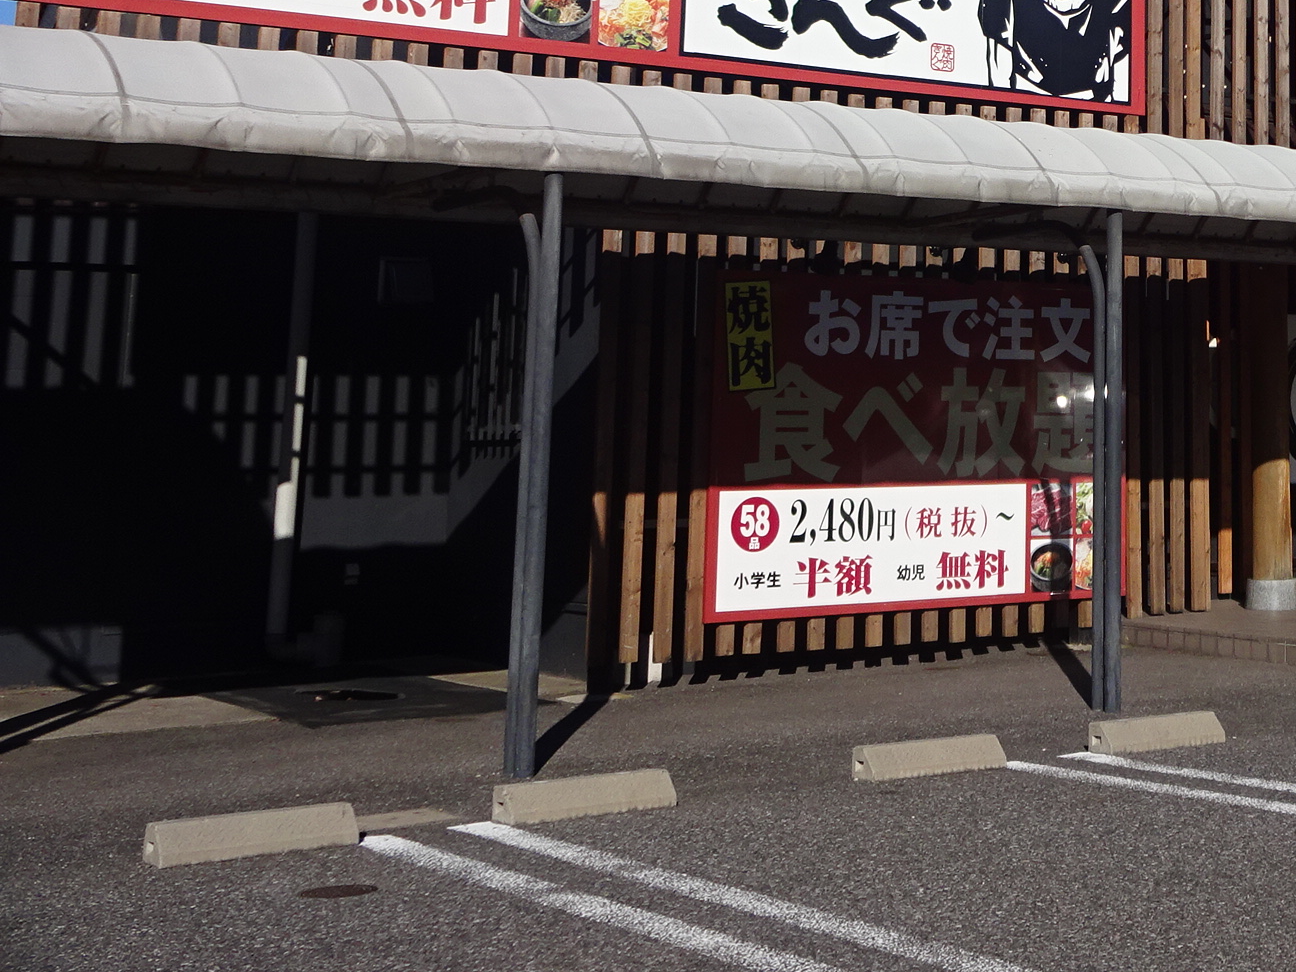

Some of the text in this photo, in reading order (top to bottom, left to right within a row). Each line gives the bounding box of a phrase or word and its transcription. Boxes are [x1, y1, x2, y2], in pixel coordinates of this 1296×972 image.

[727, 285, 773, 387] 焼肉
[803, 289, 1091, 364] お席で注文
[744, 362, 1094, 483] 食べ放題
[739, 503, 771, 537] 58
[749, 536, 761, 550] 品
[733, 548, 1010, 599] 小学生 半額 幼児 無料
